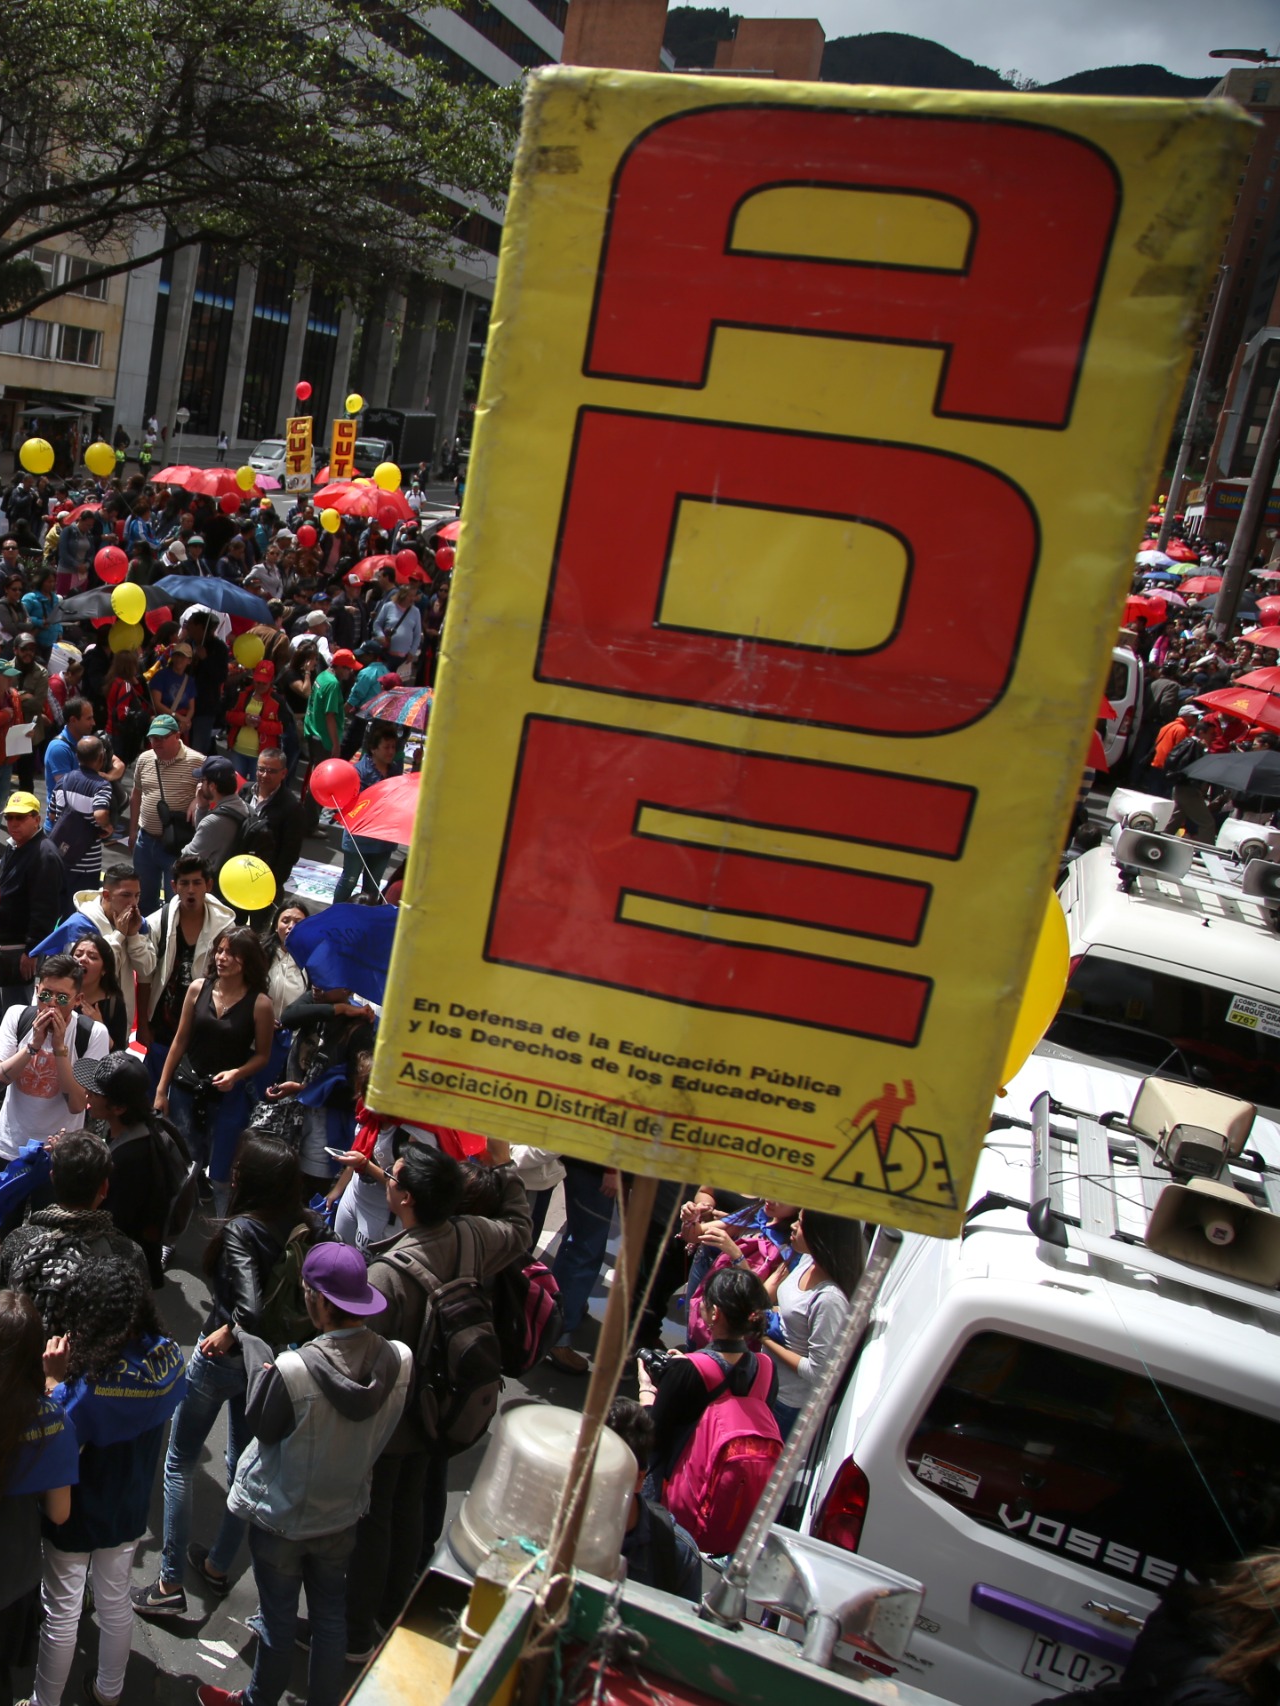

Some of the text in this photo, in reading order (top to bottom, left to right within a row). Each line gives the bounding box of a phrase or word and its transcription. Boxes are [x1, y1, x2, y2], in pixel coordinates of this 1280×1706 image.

[290, 420, 307, 473] CUT
[334, 423, 353, 477] CUT
[483, 102, 1121, 1048] ADE
[1232, 1014, 1256, 1025] #767
[1233, 1003, 1265, 1017] MARQUE
[1258, 1004, 1280, 1015] CONDU
[408, 1019, 817, 1114] y los Derechos de los Educadores
[413, 997, 842, 1097] En Defensa de la Educación Pública
[399, 1061, 817, 1168] Asociación Distrital de Educadores
